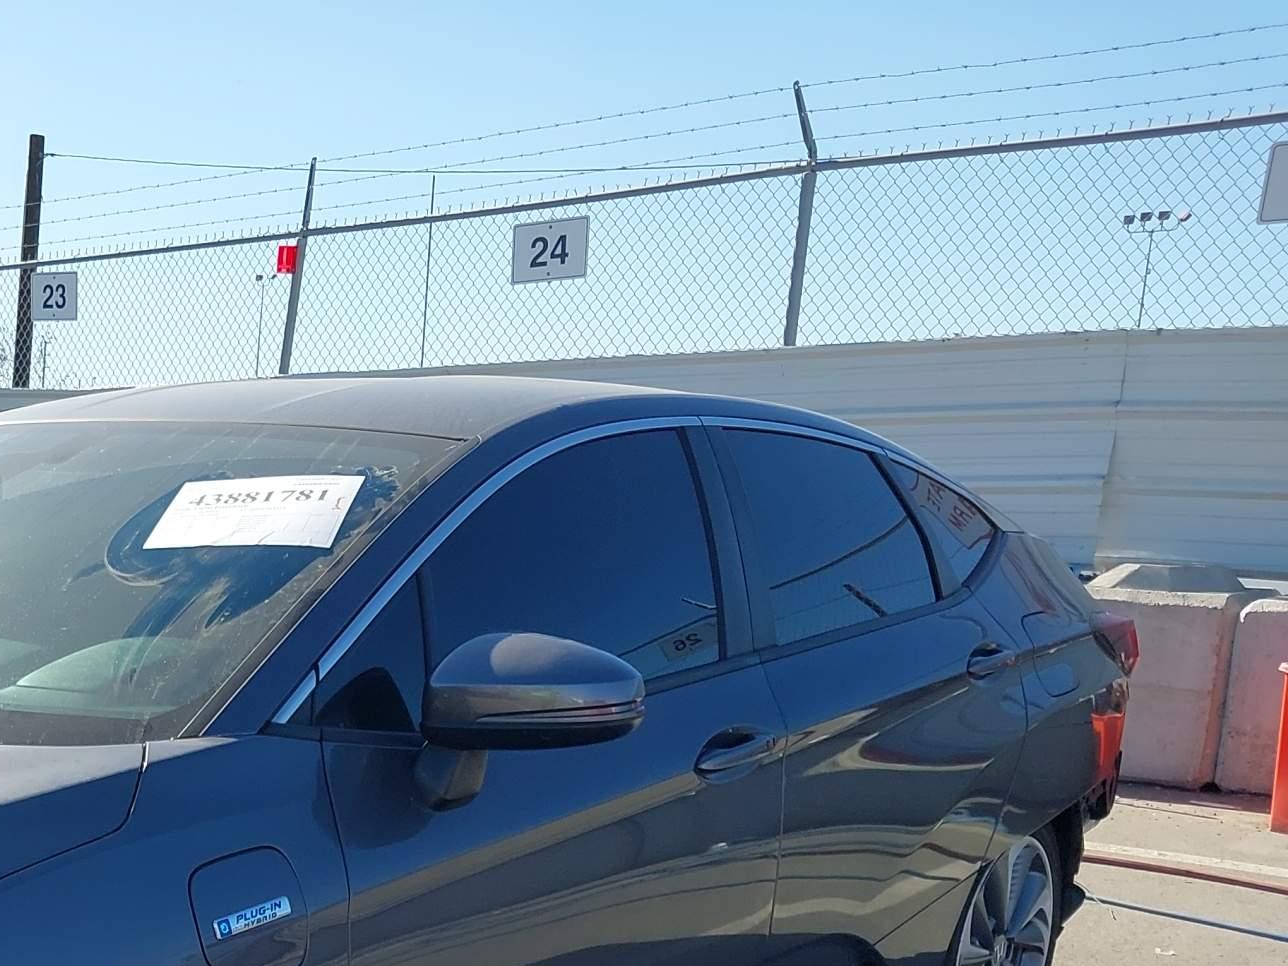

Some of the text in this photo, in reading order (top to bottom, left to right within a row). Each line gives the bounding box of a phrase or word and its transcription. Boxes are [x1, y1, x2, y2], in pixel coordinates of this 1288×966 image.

[530, 234, 569, 268] 24
[43, 284, 66, 309] 23
[189, 488, 329, 506] 43881781
[236, 900, 282, 924] PLUG-IN
